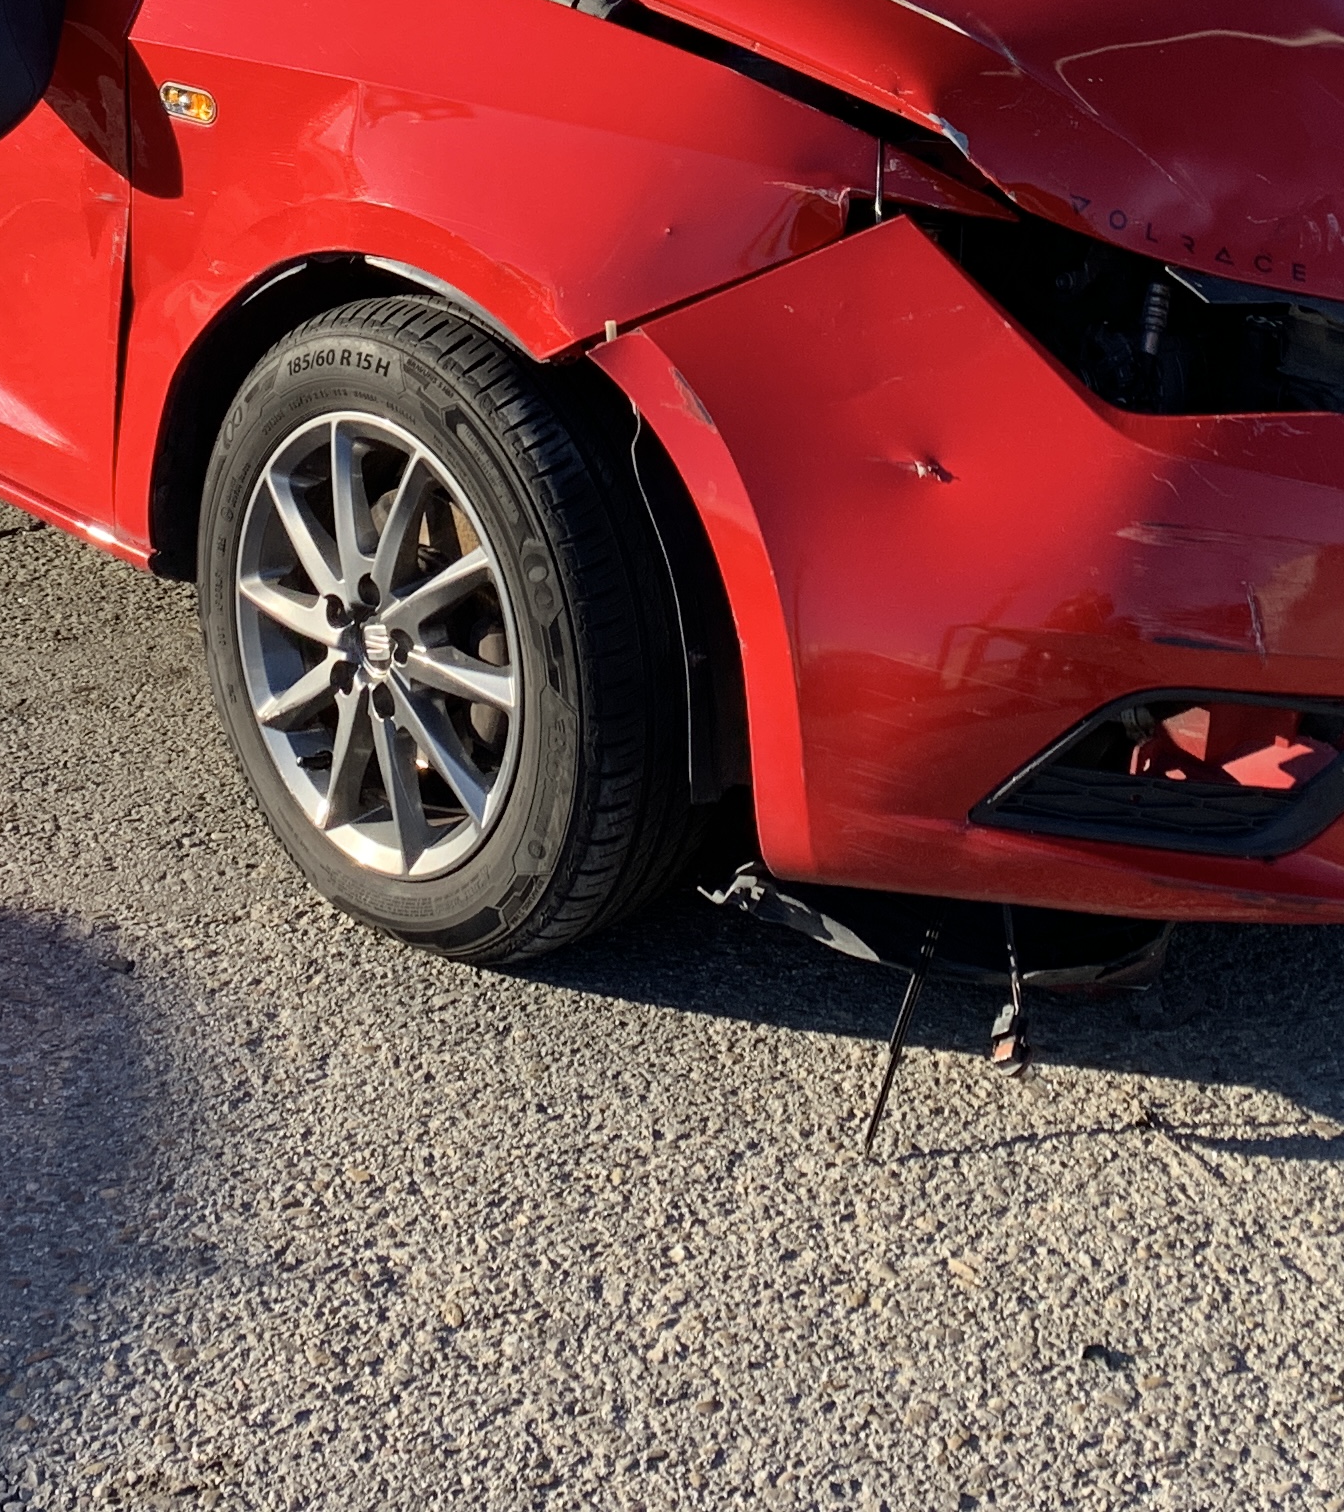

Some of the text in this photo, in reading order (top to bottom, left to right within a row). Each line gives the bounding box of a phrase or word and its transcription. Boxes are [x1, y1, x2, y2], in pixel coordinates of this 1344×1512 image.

[286, 348, 391, 378] 185/60 R 15 H
